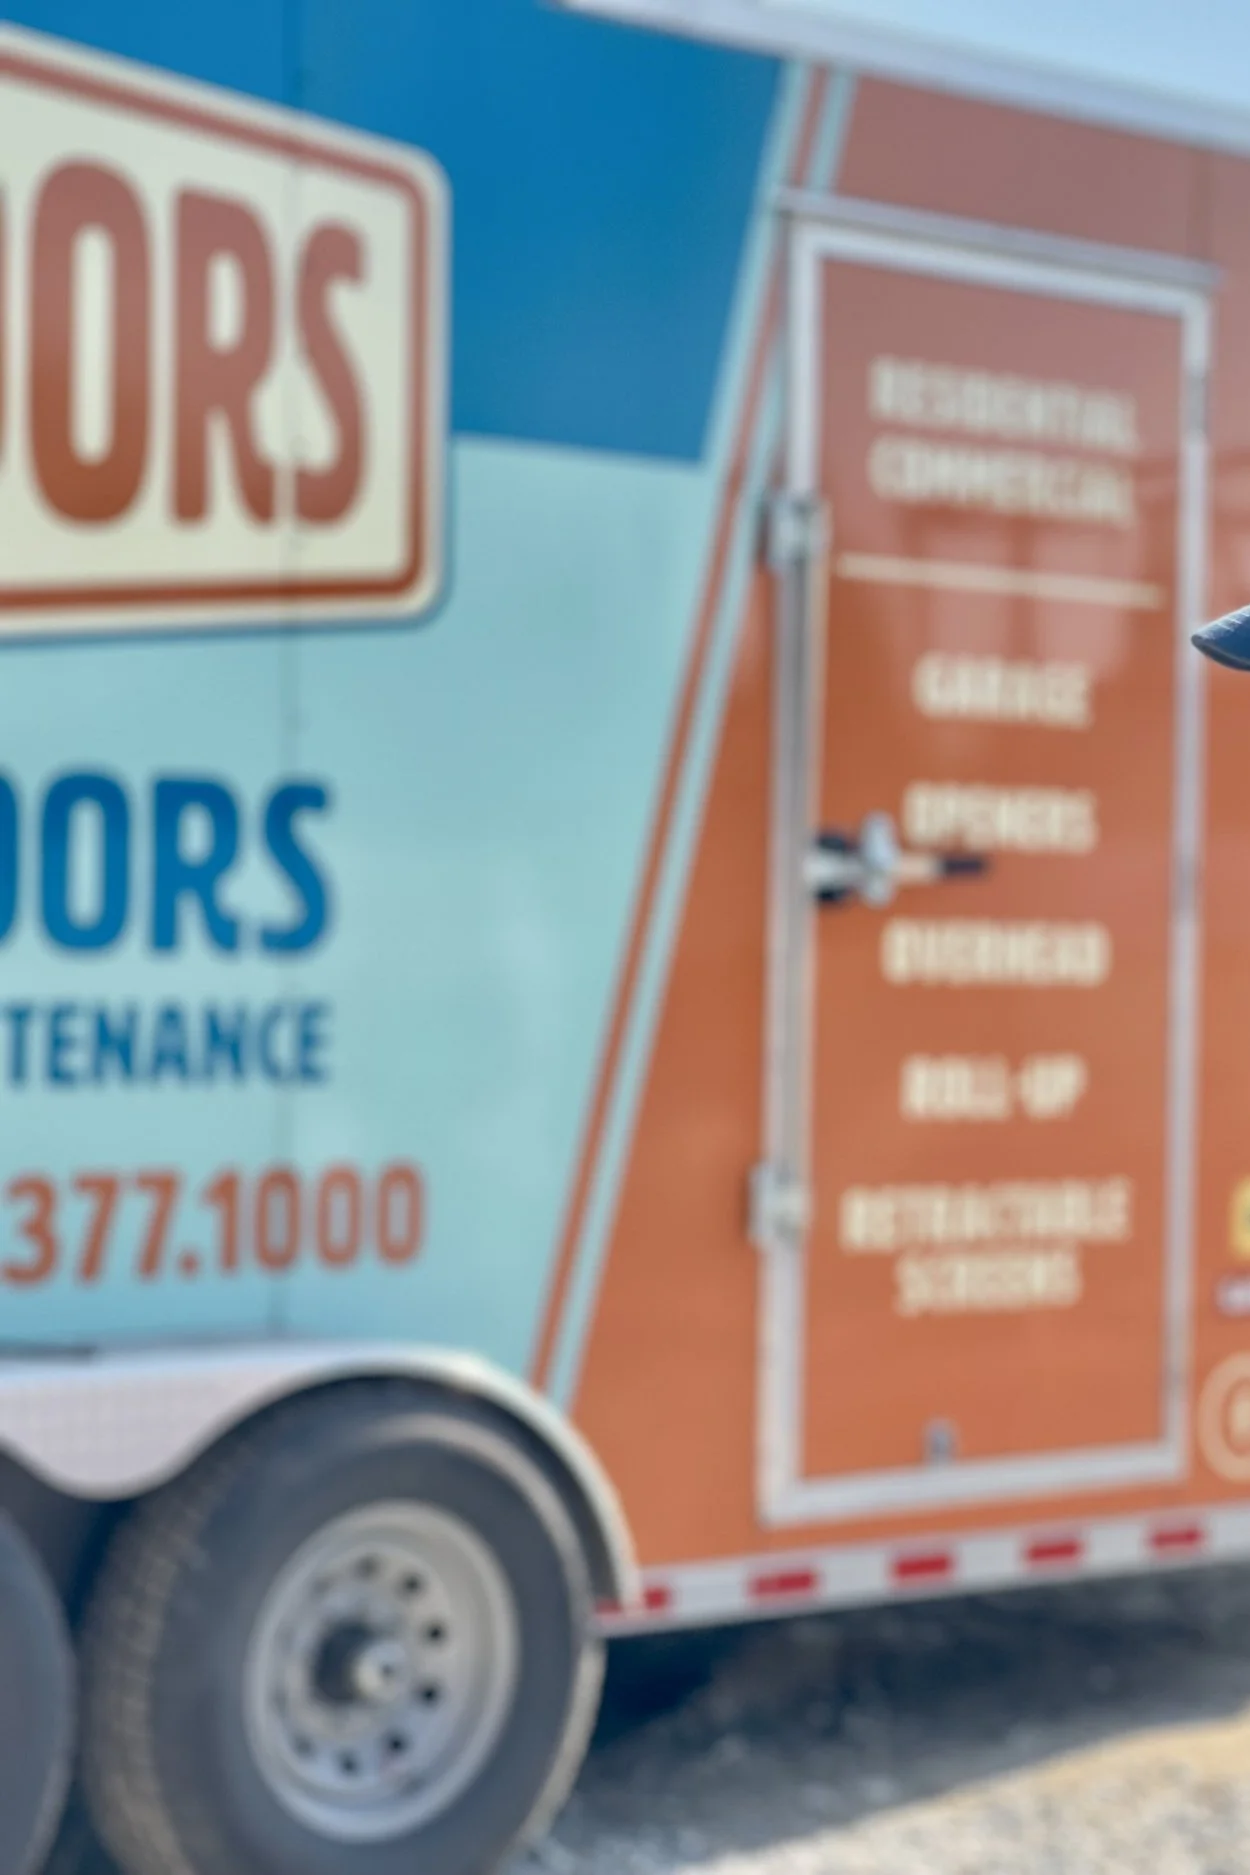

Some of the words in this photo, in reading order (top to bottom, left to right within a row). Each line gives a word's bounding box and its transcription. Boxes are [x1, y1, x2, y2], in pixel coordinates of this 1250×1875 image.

[0, 158, 368, 530] ORS
[869, 355, 1139, 453] RESIDENTIAL
[868, 435, 1135, 527] COMMERCIAL
[913, 651, 1091, 730] GARAGE
[907, 782, 1097, 853] OPENERS
[0, 767, 332, 957] ORS
[883, 917, 1110, 986] OVERHEAD
[0, 1001, 332, 1088] TENANCE
[840, 1177, 1131, 1252] RETRACTABLE
[896, 1250, 1081, 1314] SCREENS
